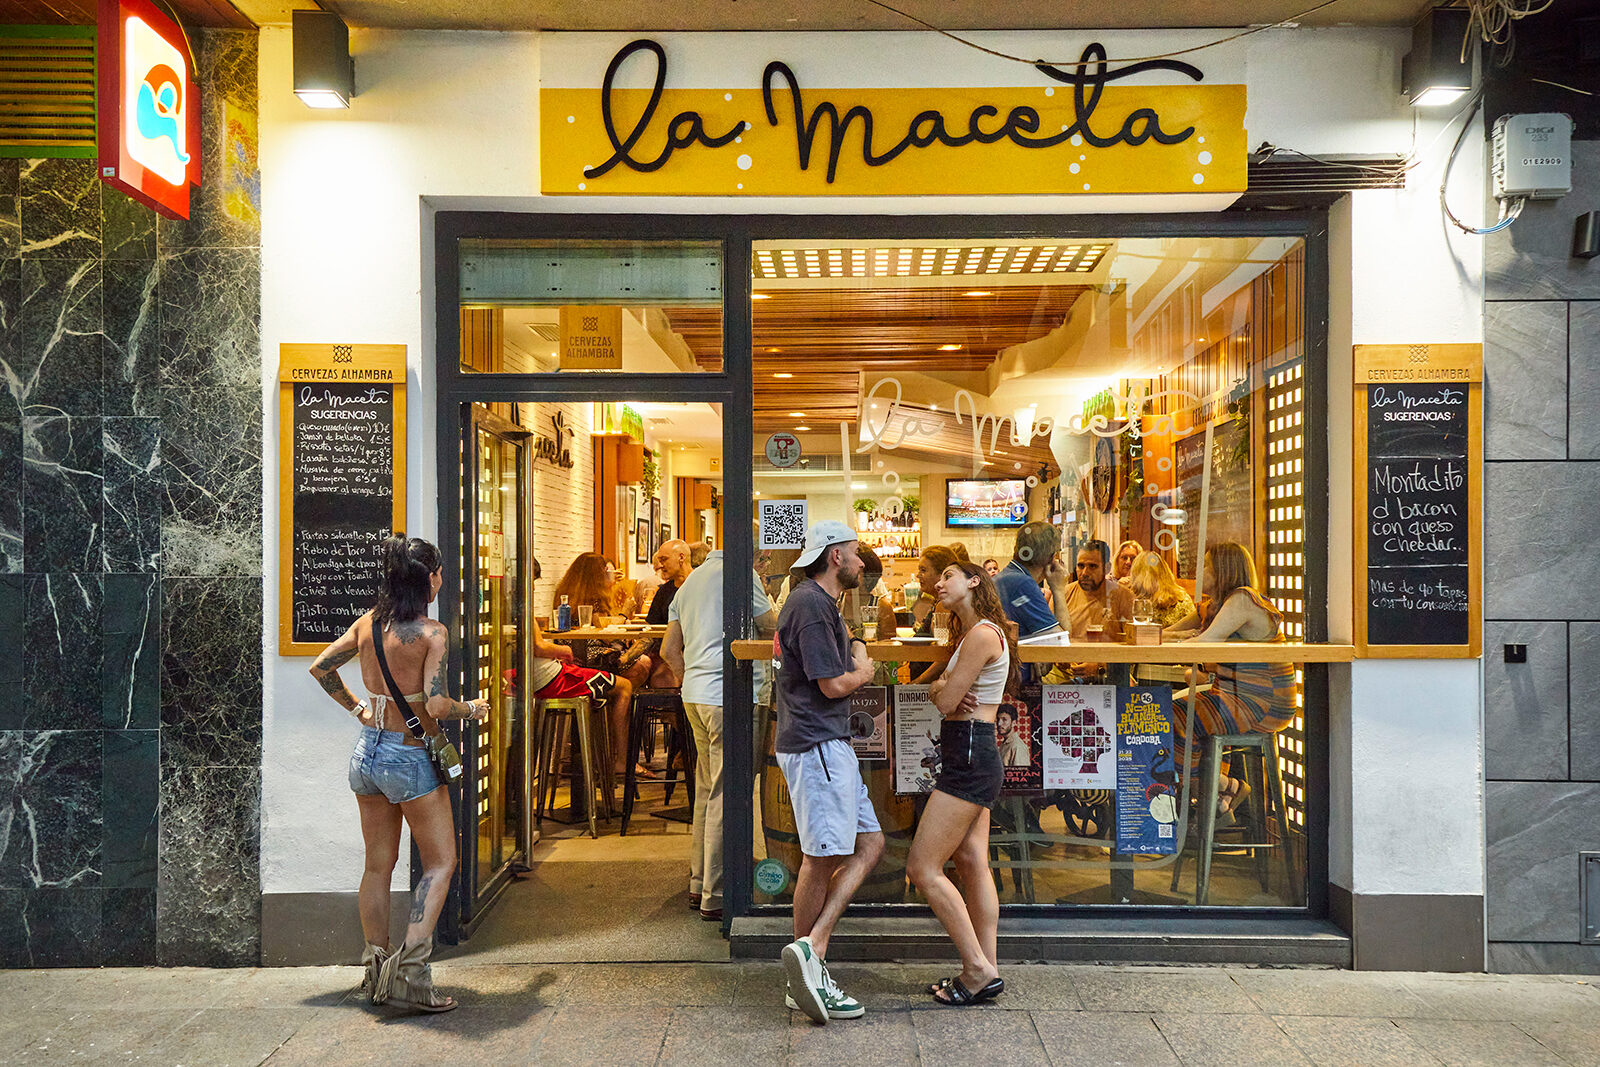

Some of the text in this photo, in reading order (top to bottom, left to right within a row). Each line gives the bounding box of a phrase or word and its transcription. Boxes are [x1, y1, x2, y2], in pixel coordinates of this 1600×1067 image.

[583, 38, 746, 180] la
[1531, 134, 1549, 142] 233
[569, 336, 612, 347] CERVEZAS
[566, 348, 615, 359] ALHAMBRA
[292, 368, 393, 380] CERVEZAS ALHAMBRA
[1368, 368, 1470, 380] CERVEZAS ALHAMBRA
[298, 385, 323, 407] la
[1371, 387, 1397, 408] la
[311, 410, 377, 420] SUGERENCIAS
[856, 377, 945, 454] la
[1383, 411, 1451, 421] SUGERENCIAS
[299, 422, 322, 433] Queso
[326, 432, 334, 441] de
[335, 432, 365, 442] bellota
[369, 434, 391, 445] 15€
[333, 466, 345, 474] de
[1374, 462, 1463, 494] Montadito
[340, 485, 350, 495] al
[1397, 496, 1457, 520] bacon
[1372, 521, 1454, 543] con queso
[299, 542, 329, 555] Rabo
[330, 543, 345, 556] de
[341, 541, 366, 556] toro
[345, 559, 356, 569] de
[330, 587, 343, 595] de
[1399, 580, 1414, 594] de
[1418, 583, 1433, 597] 40
[1435, 579, 1467, 604] tapas
[1372, 598, 1395, 608] con
[1394, 595, 1413, 609] tu
[331, 606, 350, 616] con
[1057, 691, 1080, 699] EXPO
[1130, 693, 1152, 704] LA 16
[1125, 703, 1161, 714] NOCHE
[1121, 711, 1157, 723] BLANCA
[1116, 720, 1170, 735] FLAMENCO
[1126, 734, 1162, 746] CÓRDOBA
[1004, 769, 1040, 777] STIÁN
